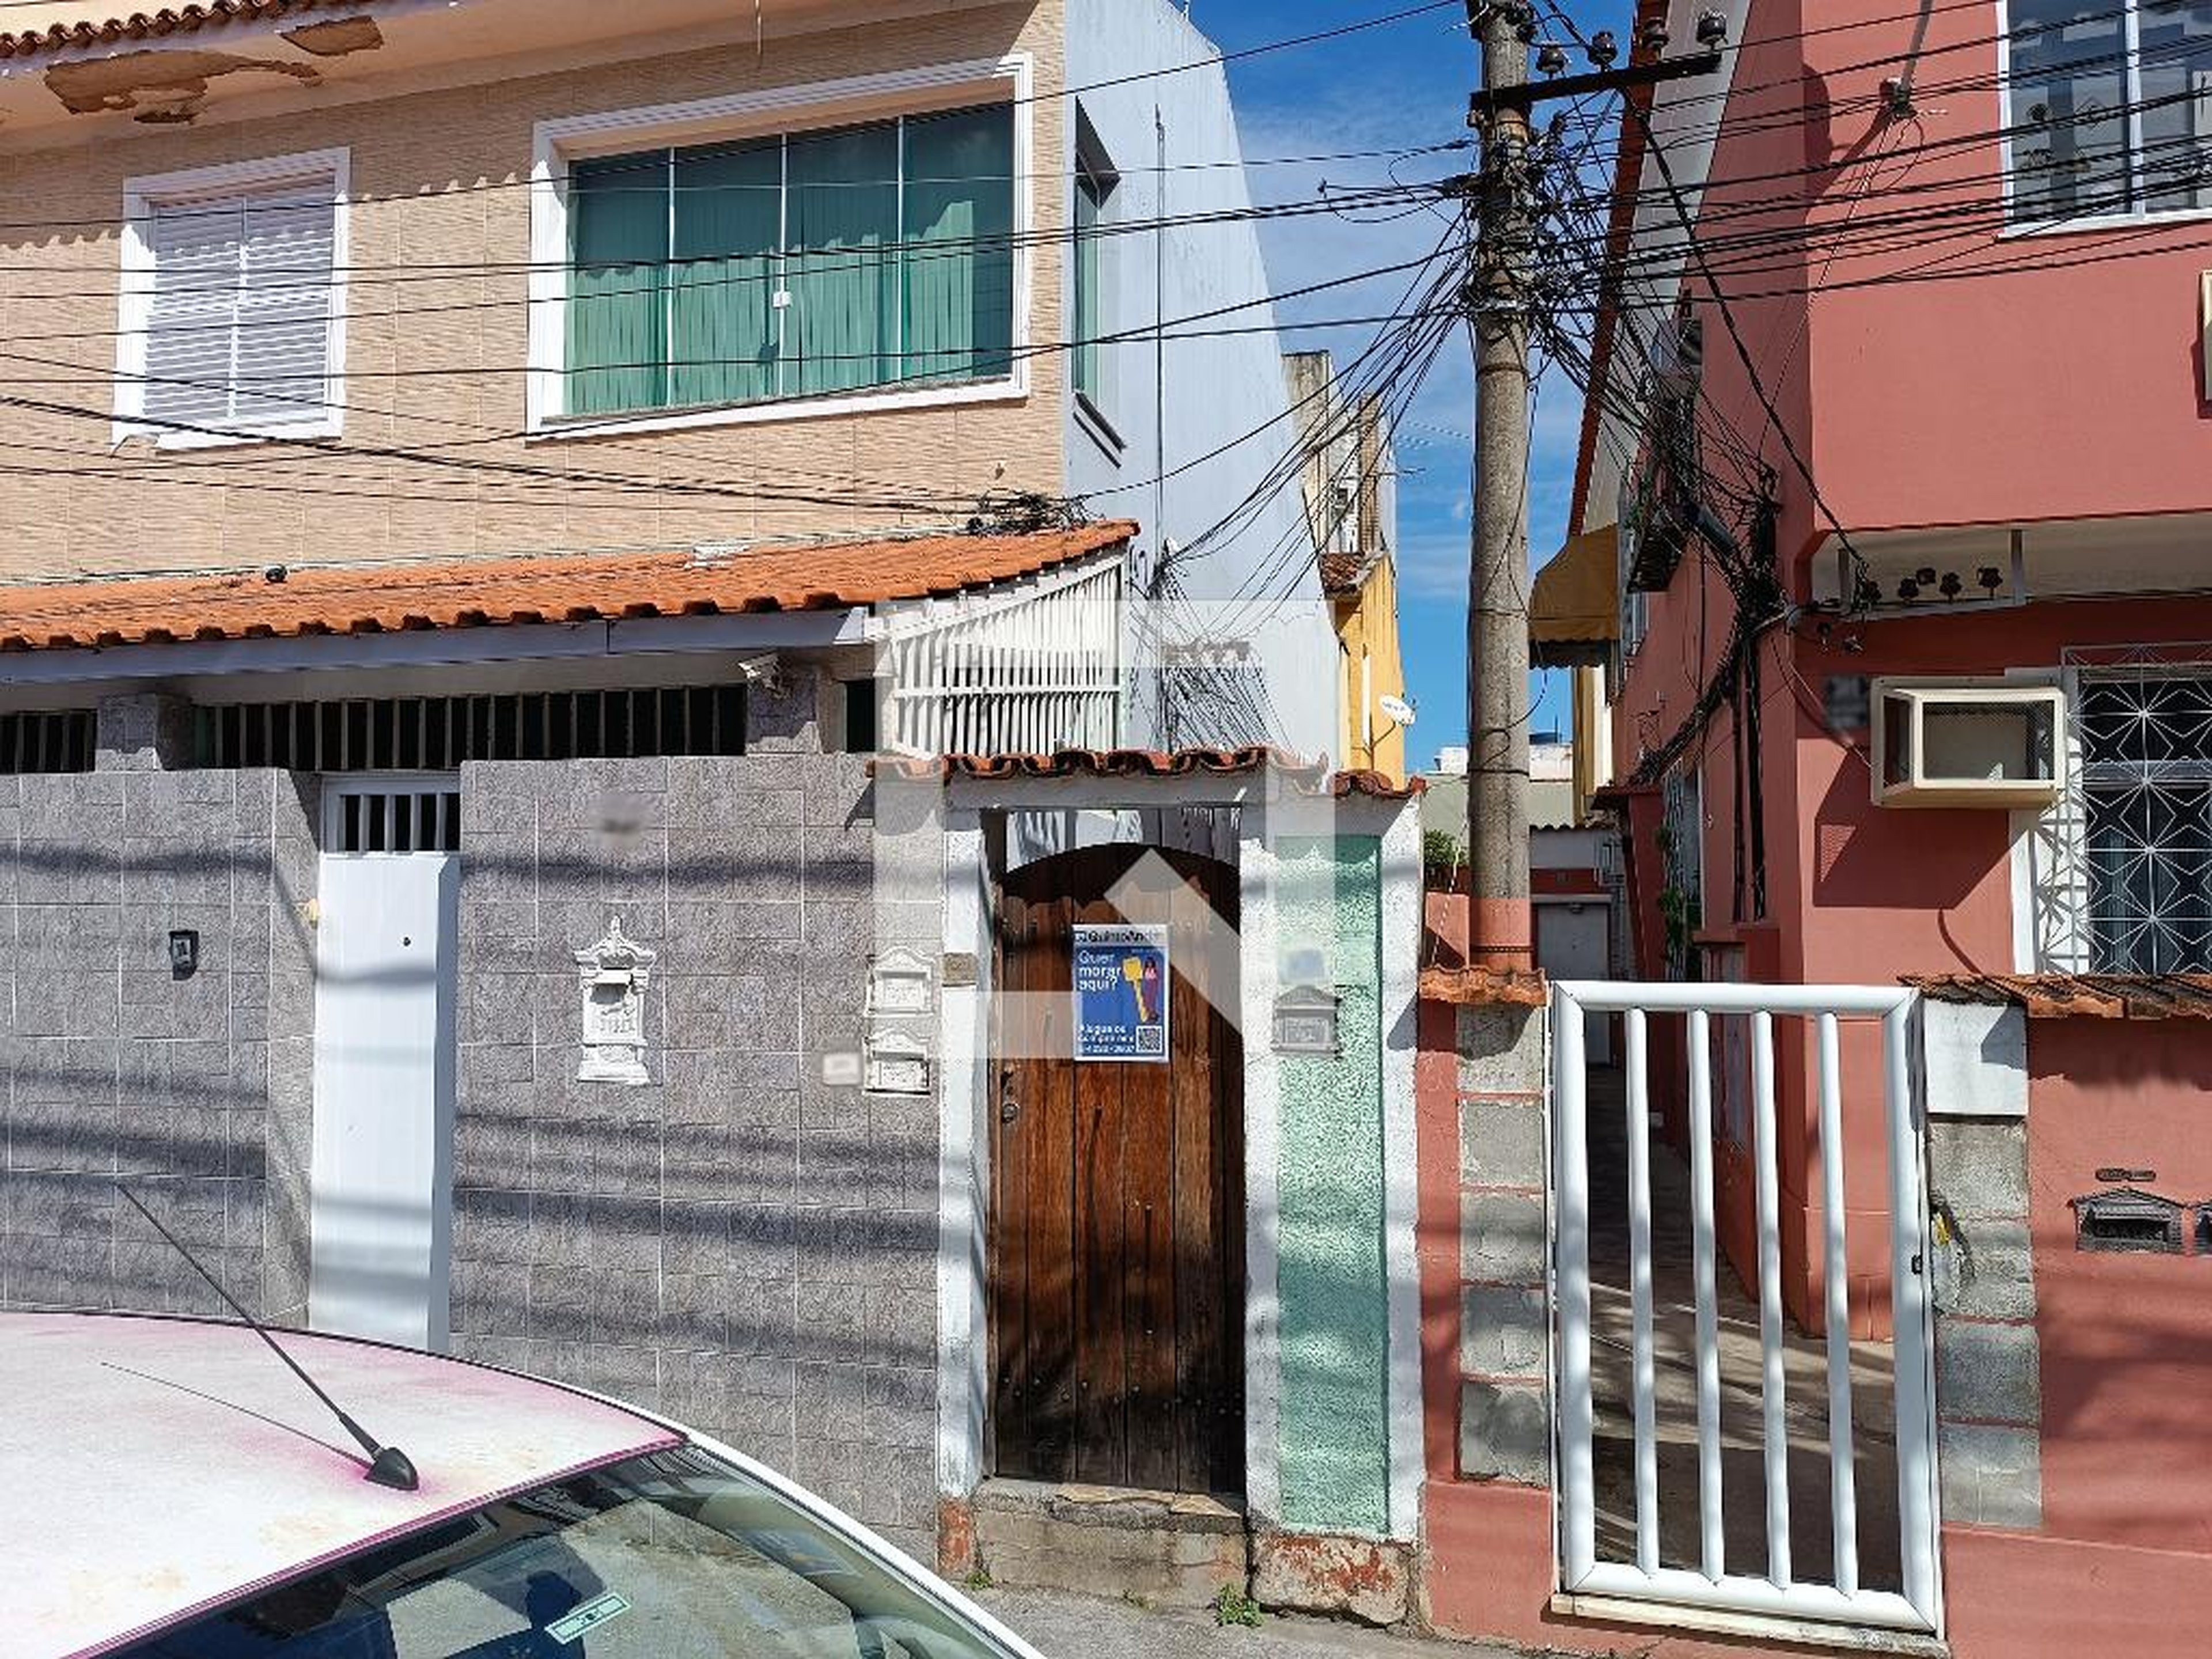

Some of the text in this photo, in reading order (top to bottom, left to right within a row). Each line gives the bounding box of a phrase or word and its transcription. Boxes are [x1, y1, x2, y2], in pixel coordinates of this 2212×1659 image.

[1079, 950, 1115, 964] Quer
[1079, 967, 1122, 977] morar
[1079, 976, 1118, 991] aqui?
